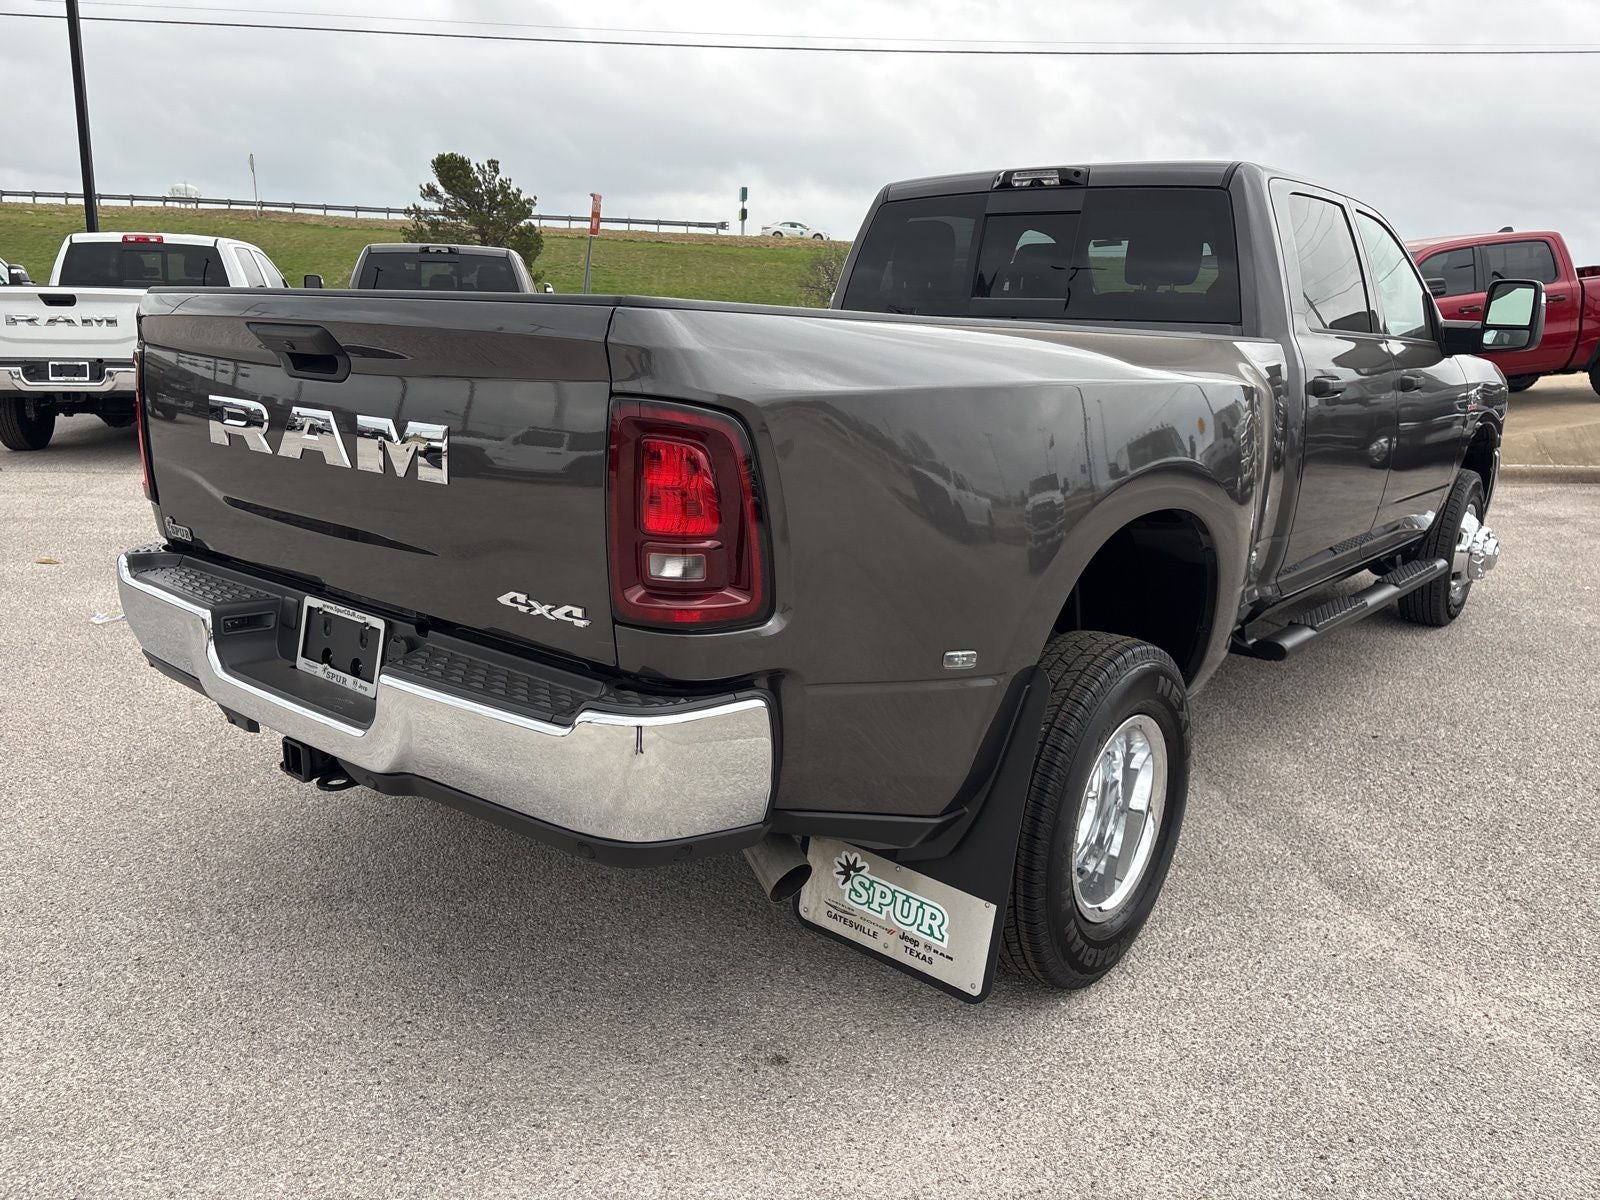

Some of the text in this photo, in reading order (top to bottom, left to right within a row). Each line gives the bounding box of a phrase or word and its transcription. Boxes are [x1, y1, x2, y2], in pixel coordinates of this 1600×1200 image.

[5, 314, 118, 327] RAM
[208, 394, 450, 486] RAM
[171, 526, 190, 540] SPUR
[325, 671, 348, 686] SPUR
[849, 874, 945, 942] SPUR
[826, 910, 934, 965] GATESVILLE TEXAS
[899, 931, 920, 948] Jeep
[933, 948, 954, 962] RAM
